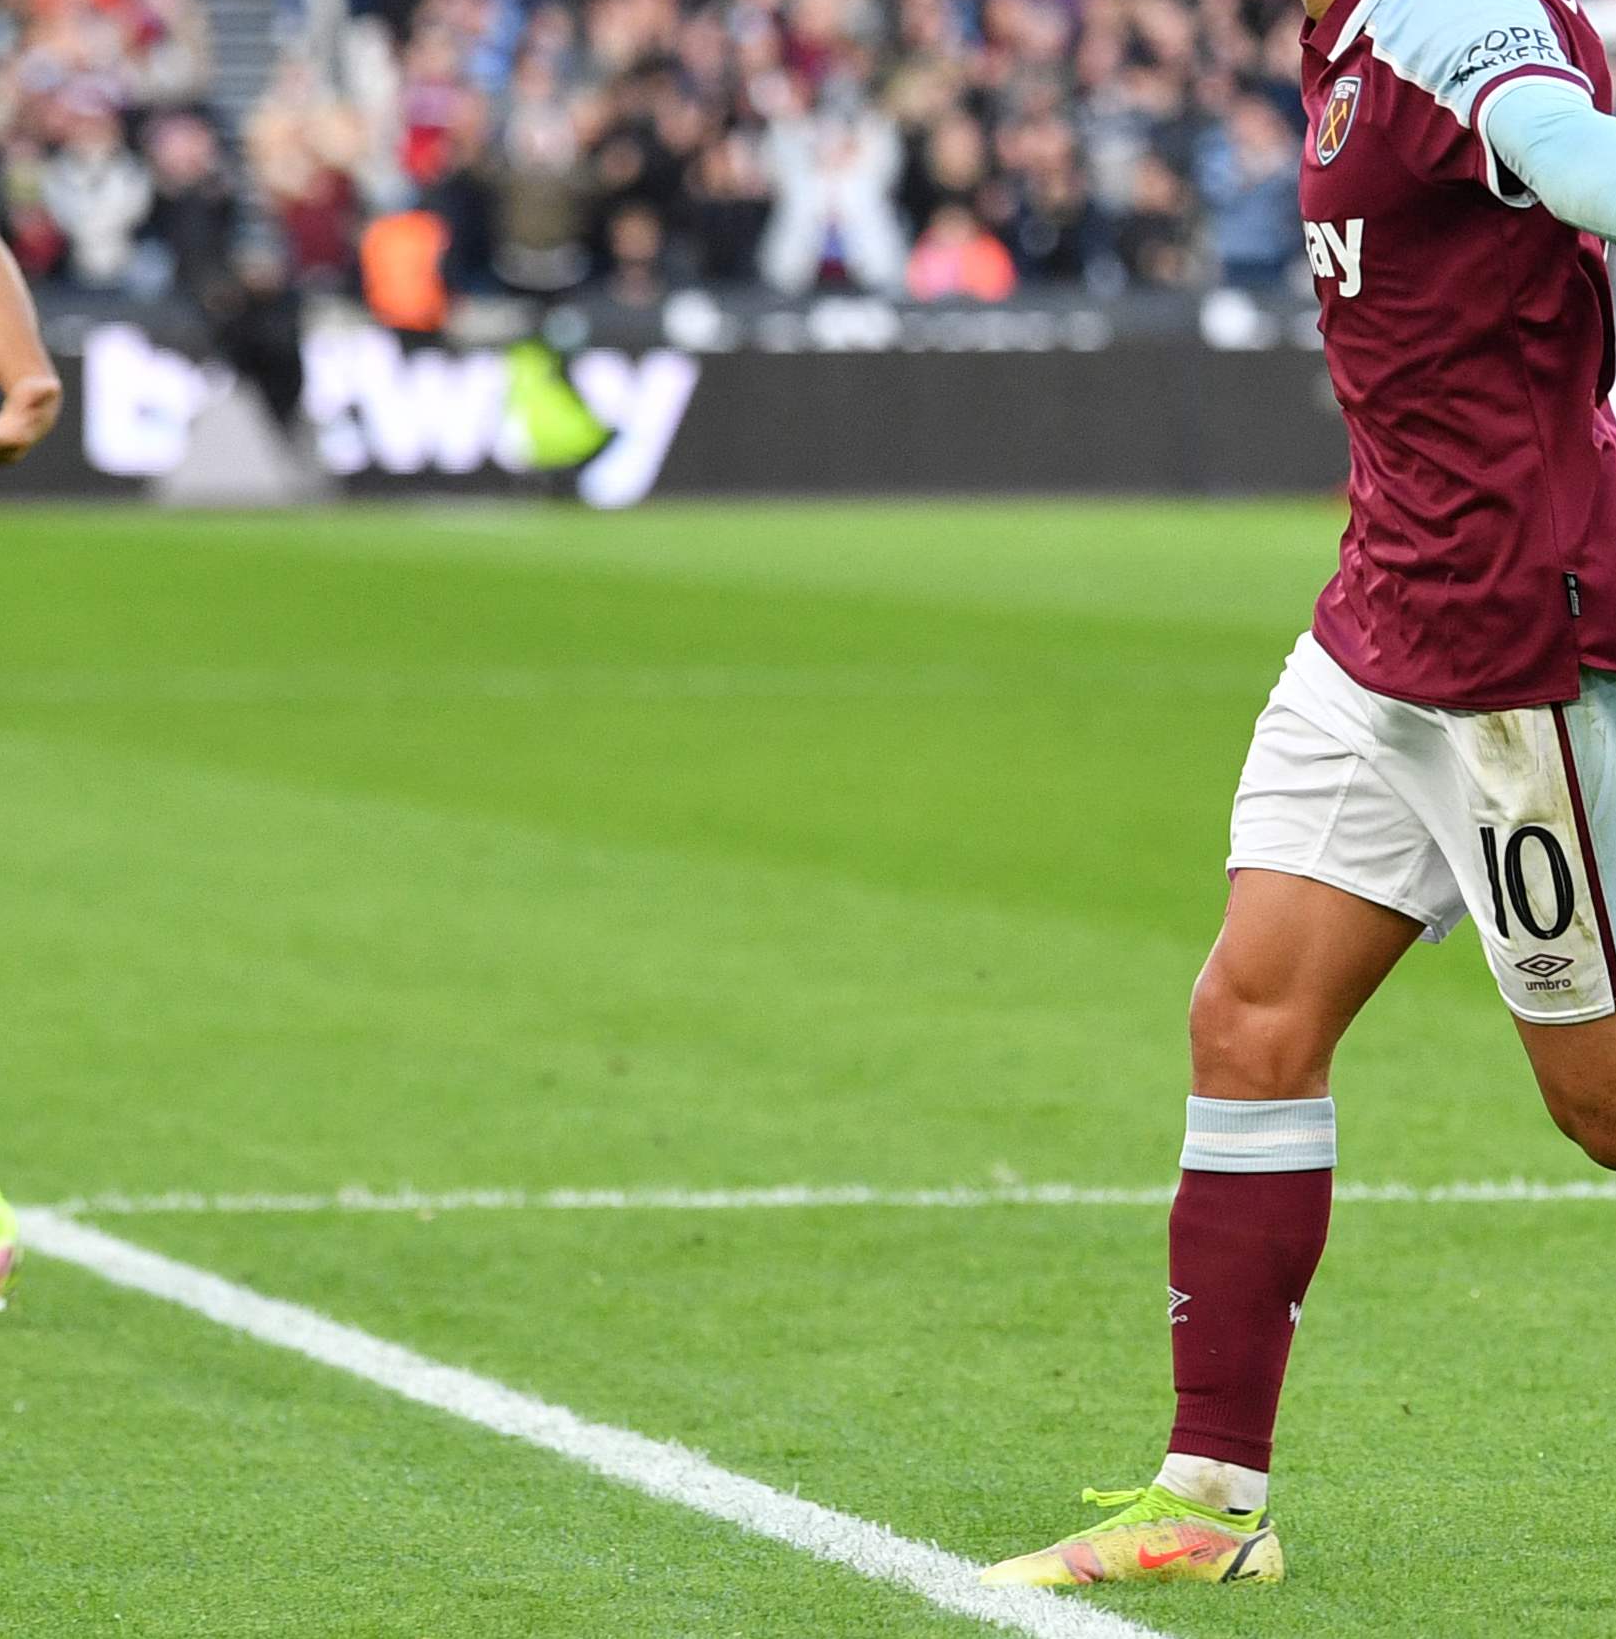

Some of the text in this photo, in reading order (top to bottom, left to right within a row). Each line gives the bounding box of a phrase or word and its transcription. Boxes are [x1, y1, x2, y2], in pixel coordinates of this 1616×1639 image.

[81, 320, 703, 512] btwy
[1479, 825, 1575, 941] 10
[1525, 978, 1572, 991] umbro
